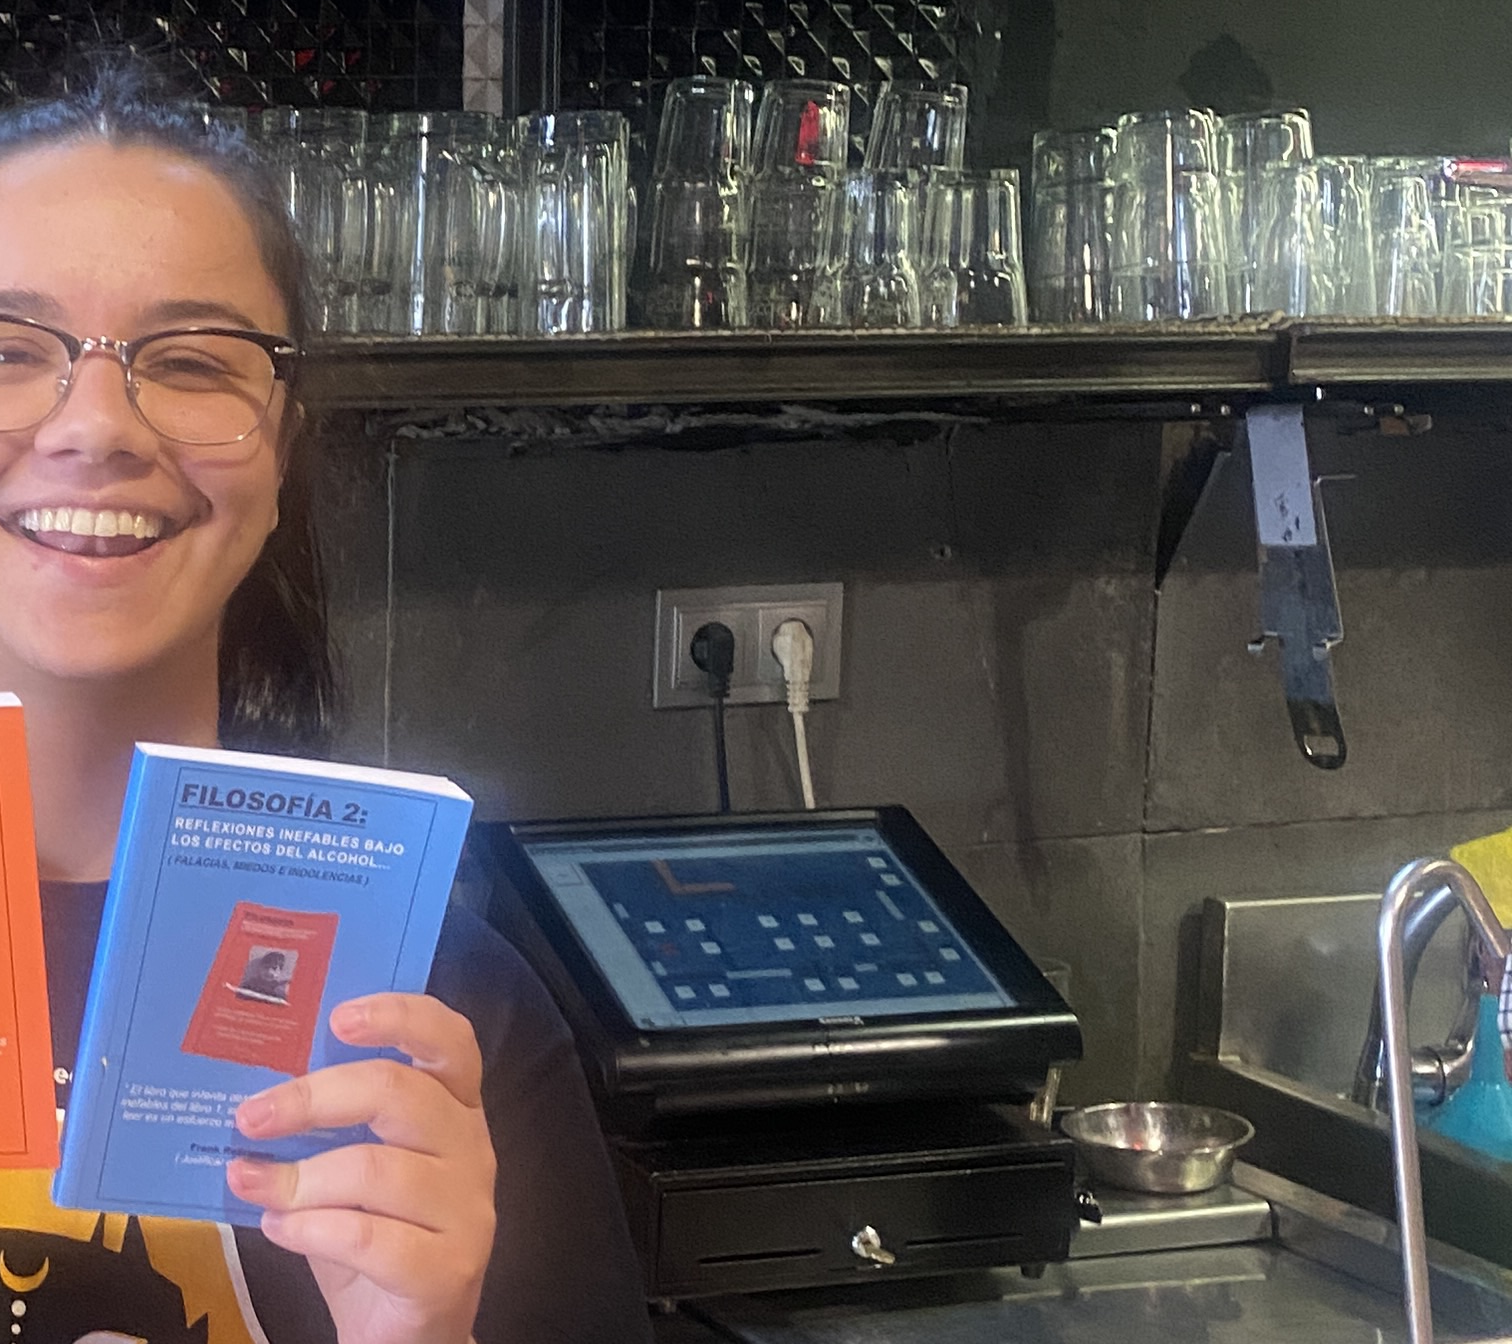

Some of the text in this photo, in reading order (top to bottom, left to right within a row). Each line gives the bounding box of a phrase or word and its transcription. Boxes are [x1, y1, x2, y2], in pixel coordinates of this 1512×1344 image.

[180, 783, 369, 824] FILOSOFÍA 2:
[171, 833, 200, 848] LOS
[205, 836, 271, 855] EFECTOS
[276, 844, 304, 858] DEL
[175, 816, 405, 856] REFLEXIONES INEFABLES BAJO
